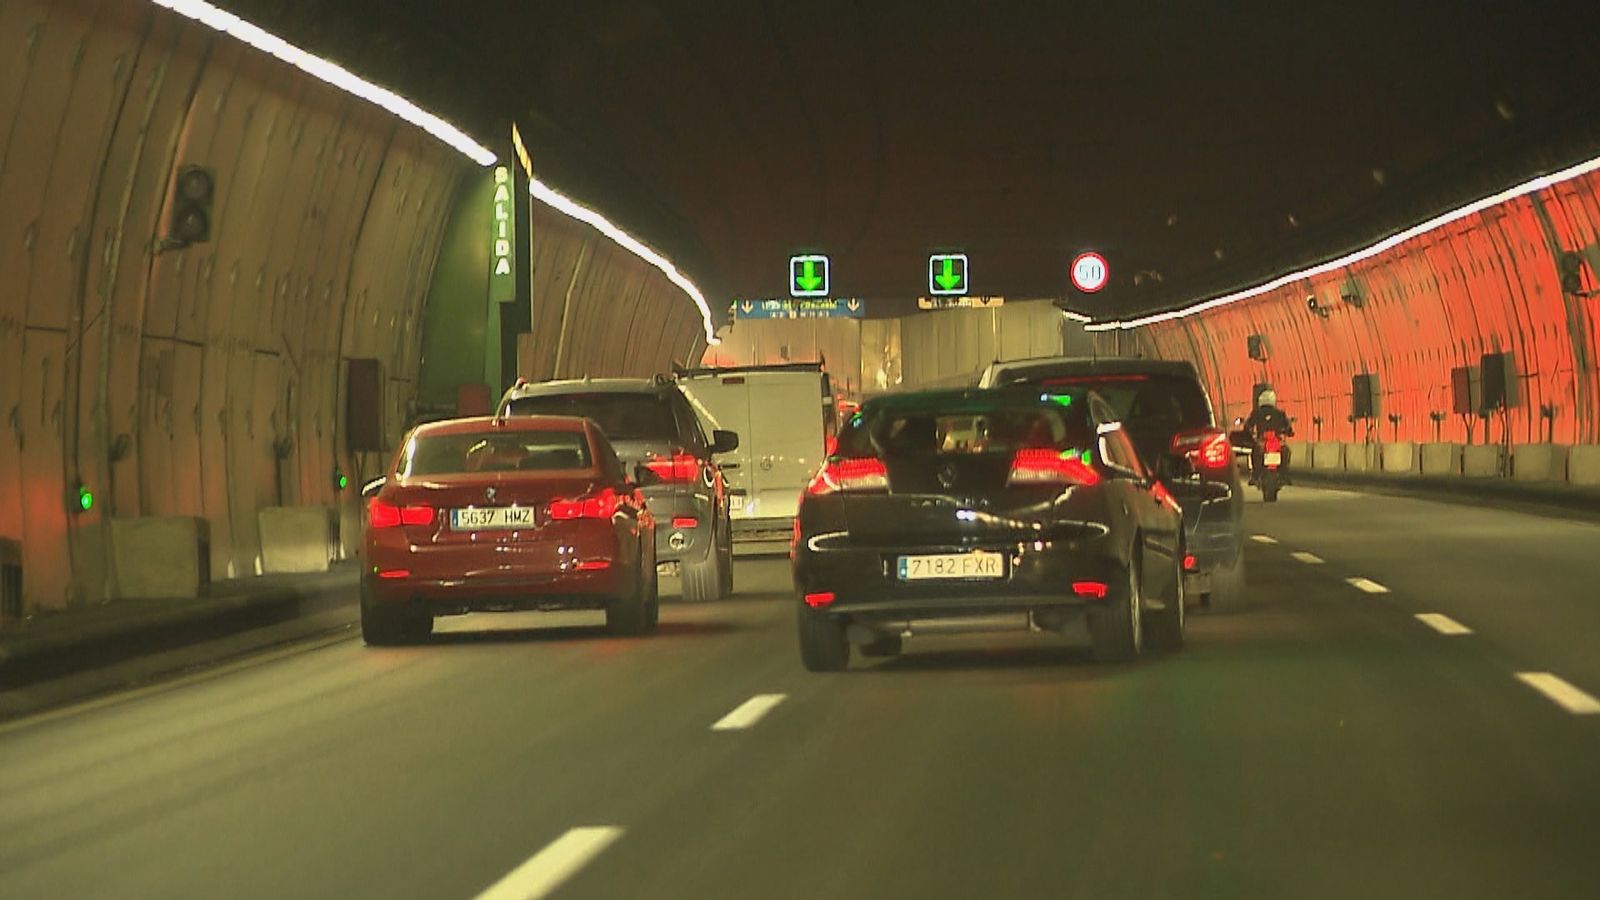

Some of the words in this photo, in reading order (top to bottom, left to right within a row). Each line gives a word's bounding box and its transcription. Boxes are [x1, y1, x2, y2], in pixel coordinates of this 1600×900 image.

[494, 166, 511, 275] SALIDA
[1079, 264, 1101, 281] 50
[461, 510, 495, 525] 5637
[504, 509, 530, 523] HMZ
[912, 558, 956, 575] 7182
[962, 558, 997, 574] FXR
